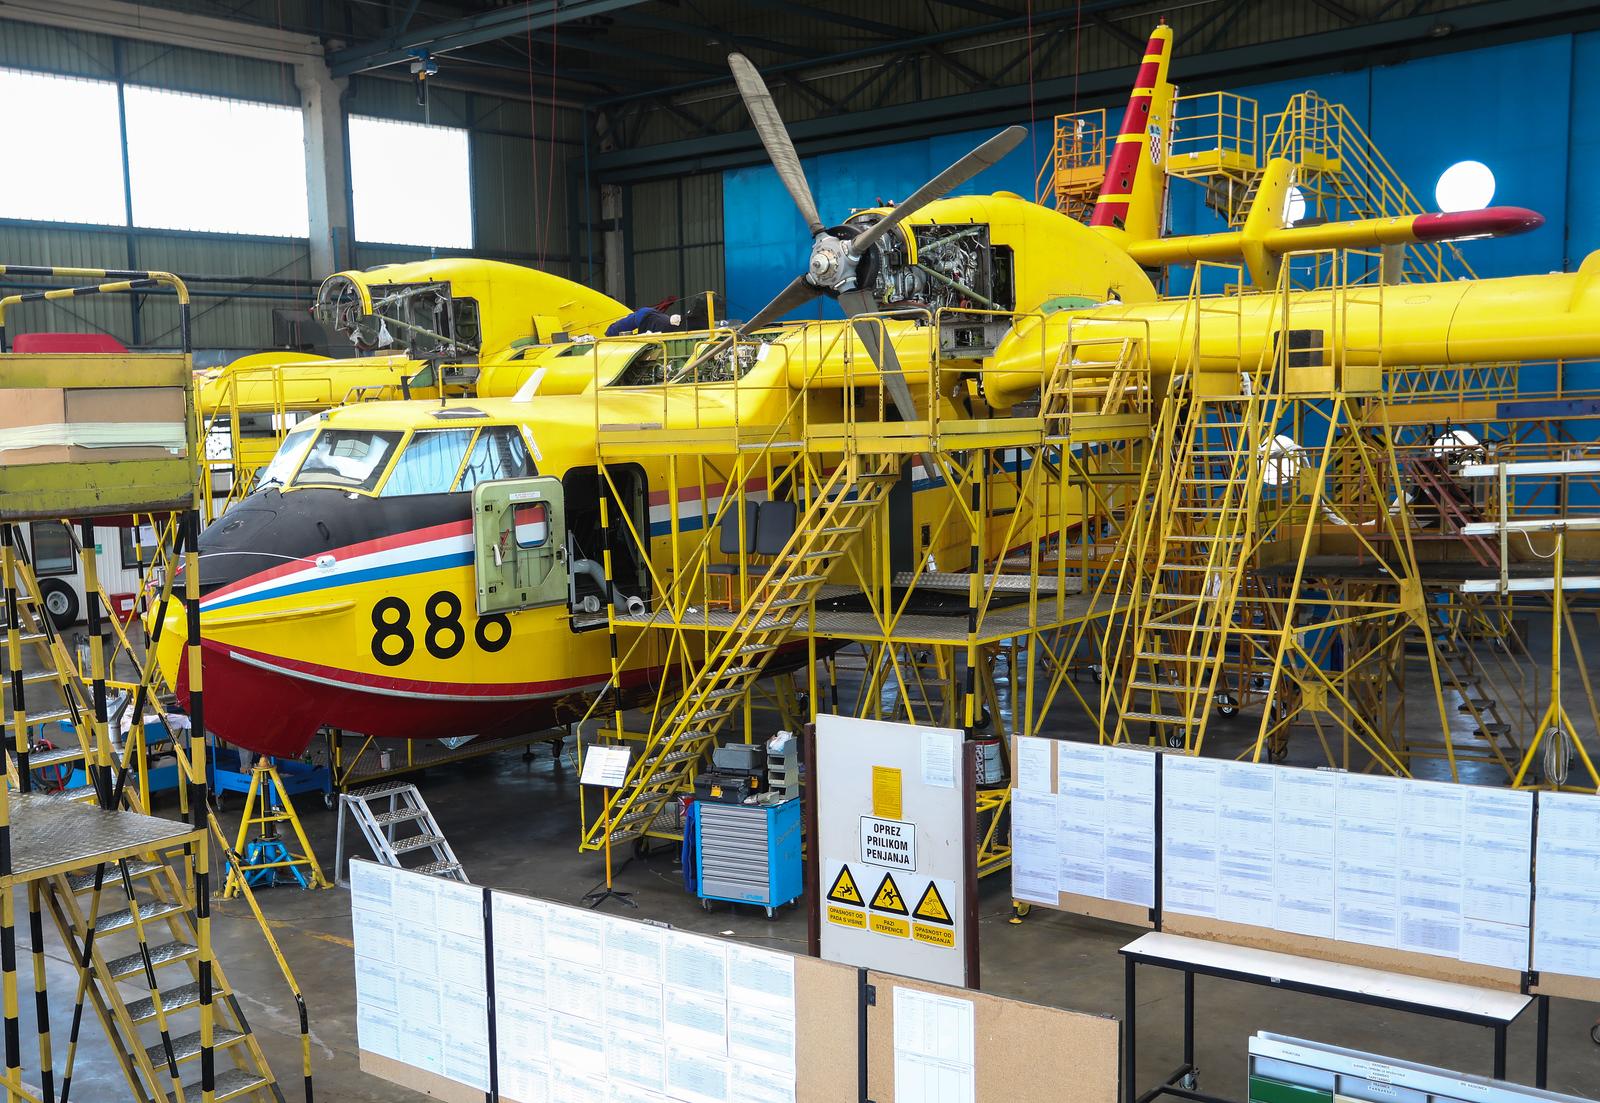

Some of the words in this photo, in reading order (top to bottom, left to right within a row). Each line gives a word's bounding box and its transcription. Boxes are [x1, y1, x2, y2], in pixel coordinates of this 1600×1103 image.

[873, 823, 901, 837] OPREZ
[867, 835, 908, 851] PRILIKOM
[866, 848, 910, 864] PENJANJA
[829, 907, 855, 917] OPASNOST
[830, 914, 843, 922] PADA
[876, 924, 904, 934] STEPENICE
[883, 919, 895, 927] PAZI
[914, 926, 942, 936] OPASNOST
[943, 930, 952, 938] OD
[916, 932, 951, 945] PROPADANJA
